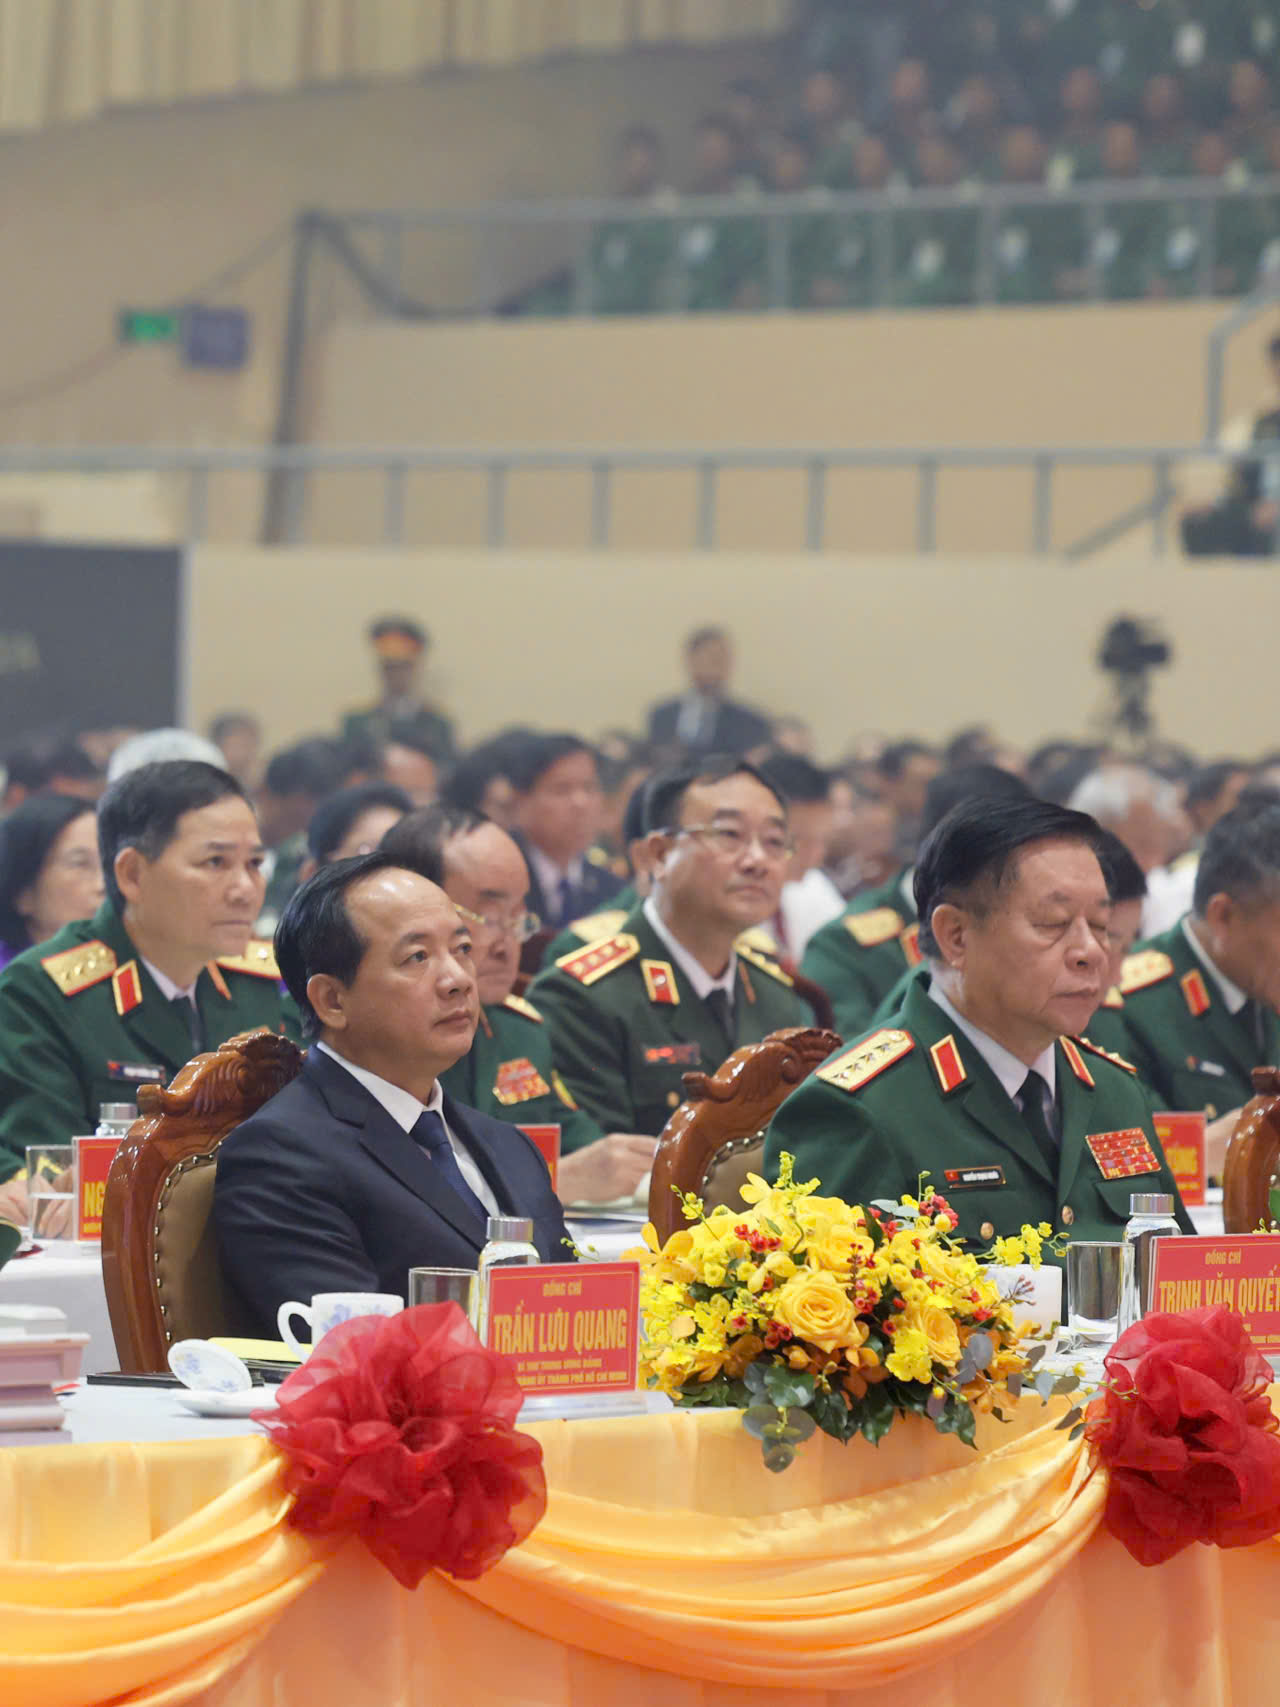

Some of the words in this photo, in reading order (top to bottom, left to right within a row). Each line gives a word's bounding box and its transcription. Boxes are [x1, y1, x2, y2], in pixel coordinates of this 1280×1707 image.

[1205, 1271, 1235, 1314] VĂN
[539, 1307, 569, 1353] LƯU
[573, 1308, 627, 1355] QUANG
